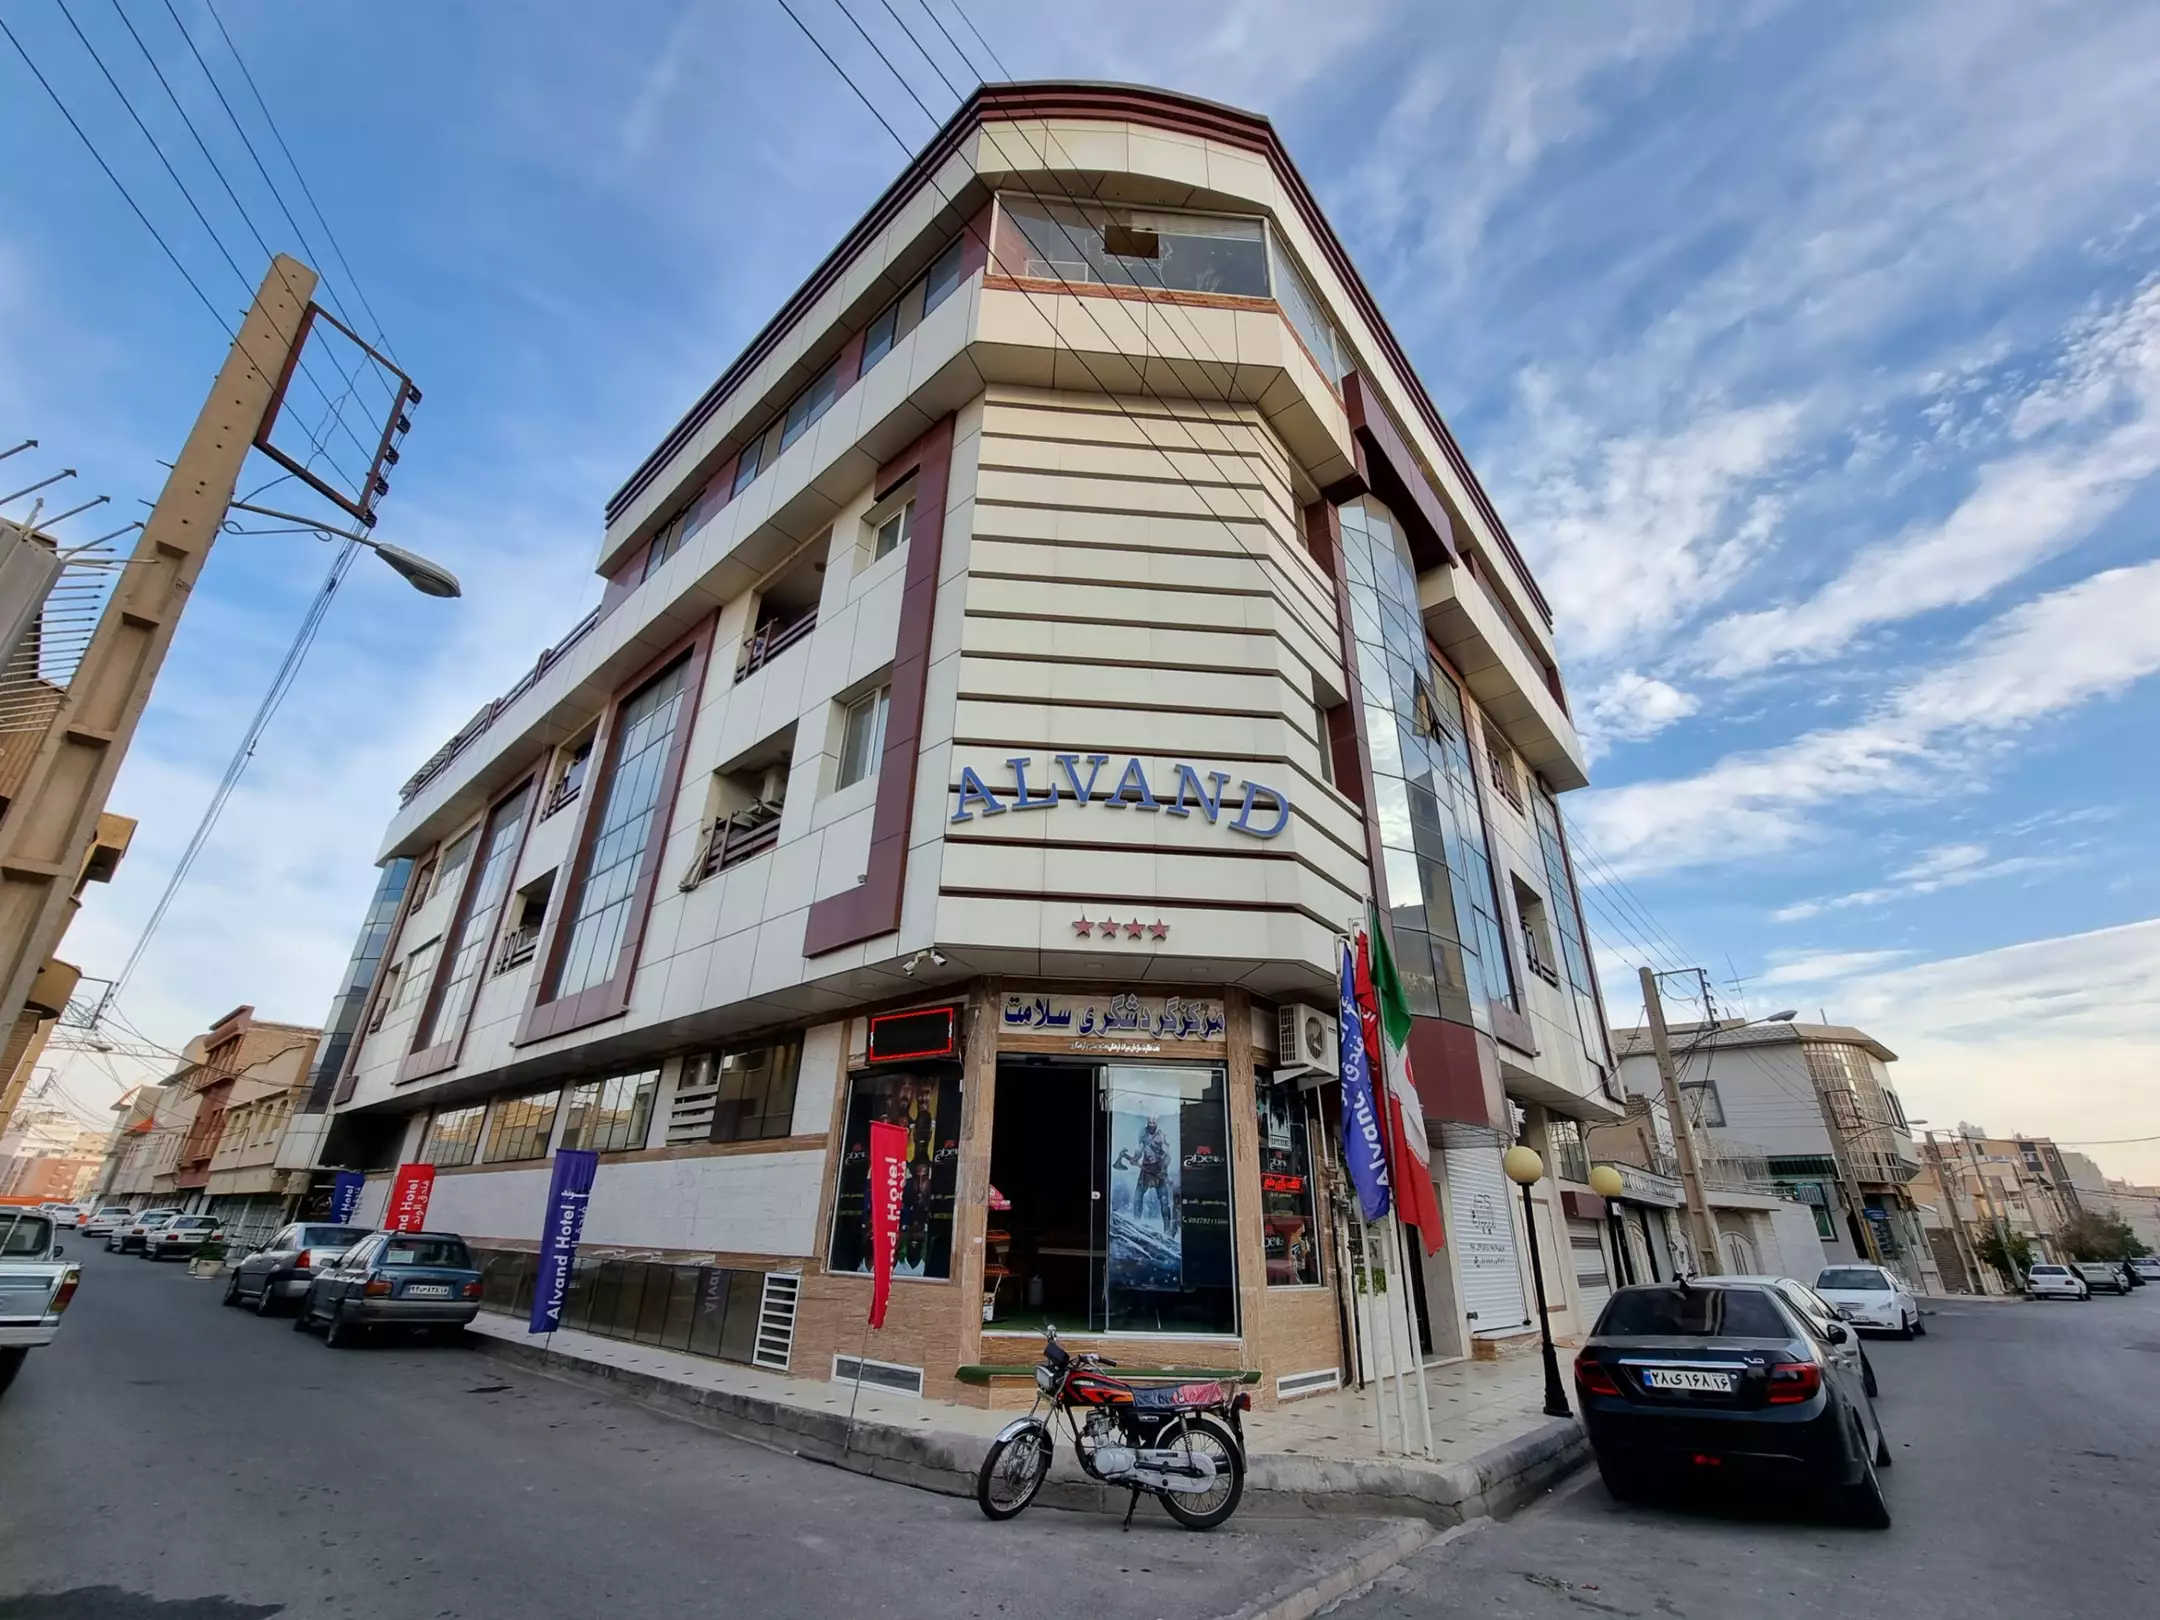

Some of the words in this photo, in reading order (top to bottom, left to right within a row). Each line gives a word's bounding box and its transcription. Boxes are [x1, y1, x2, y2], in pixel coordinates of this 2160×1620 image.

[950, 754, 1290, 840] ALVAND
[1003, 996, 1072, 1029] سلامت
[1077, 993, 1180, 1039] گردشگری
[1173, 1001, 1225, 1041] مرکز
[341, 1185, 355, 1211] Hotel
[400, 1179, 419, 1211] Hotel
[884, 1156, 899, 1221] Hotel
[413, 1204, 424, 1225] الوند
[555, 1205, 576, 1249] Hotel
[546, 1255, 569, 1320] Alvand
[1712, 1378, 1728, 1390] ۱۶
